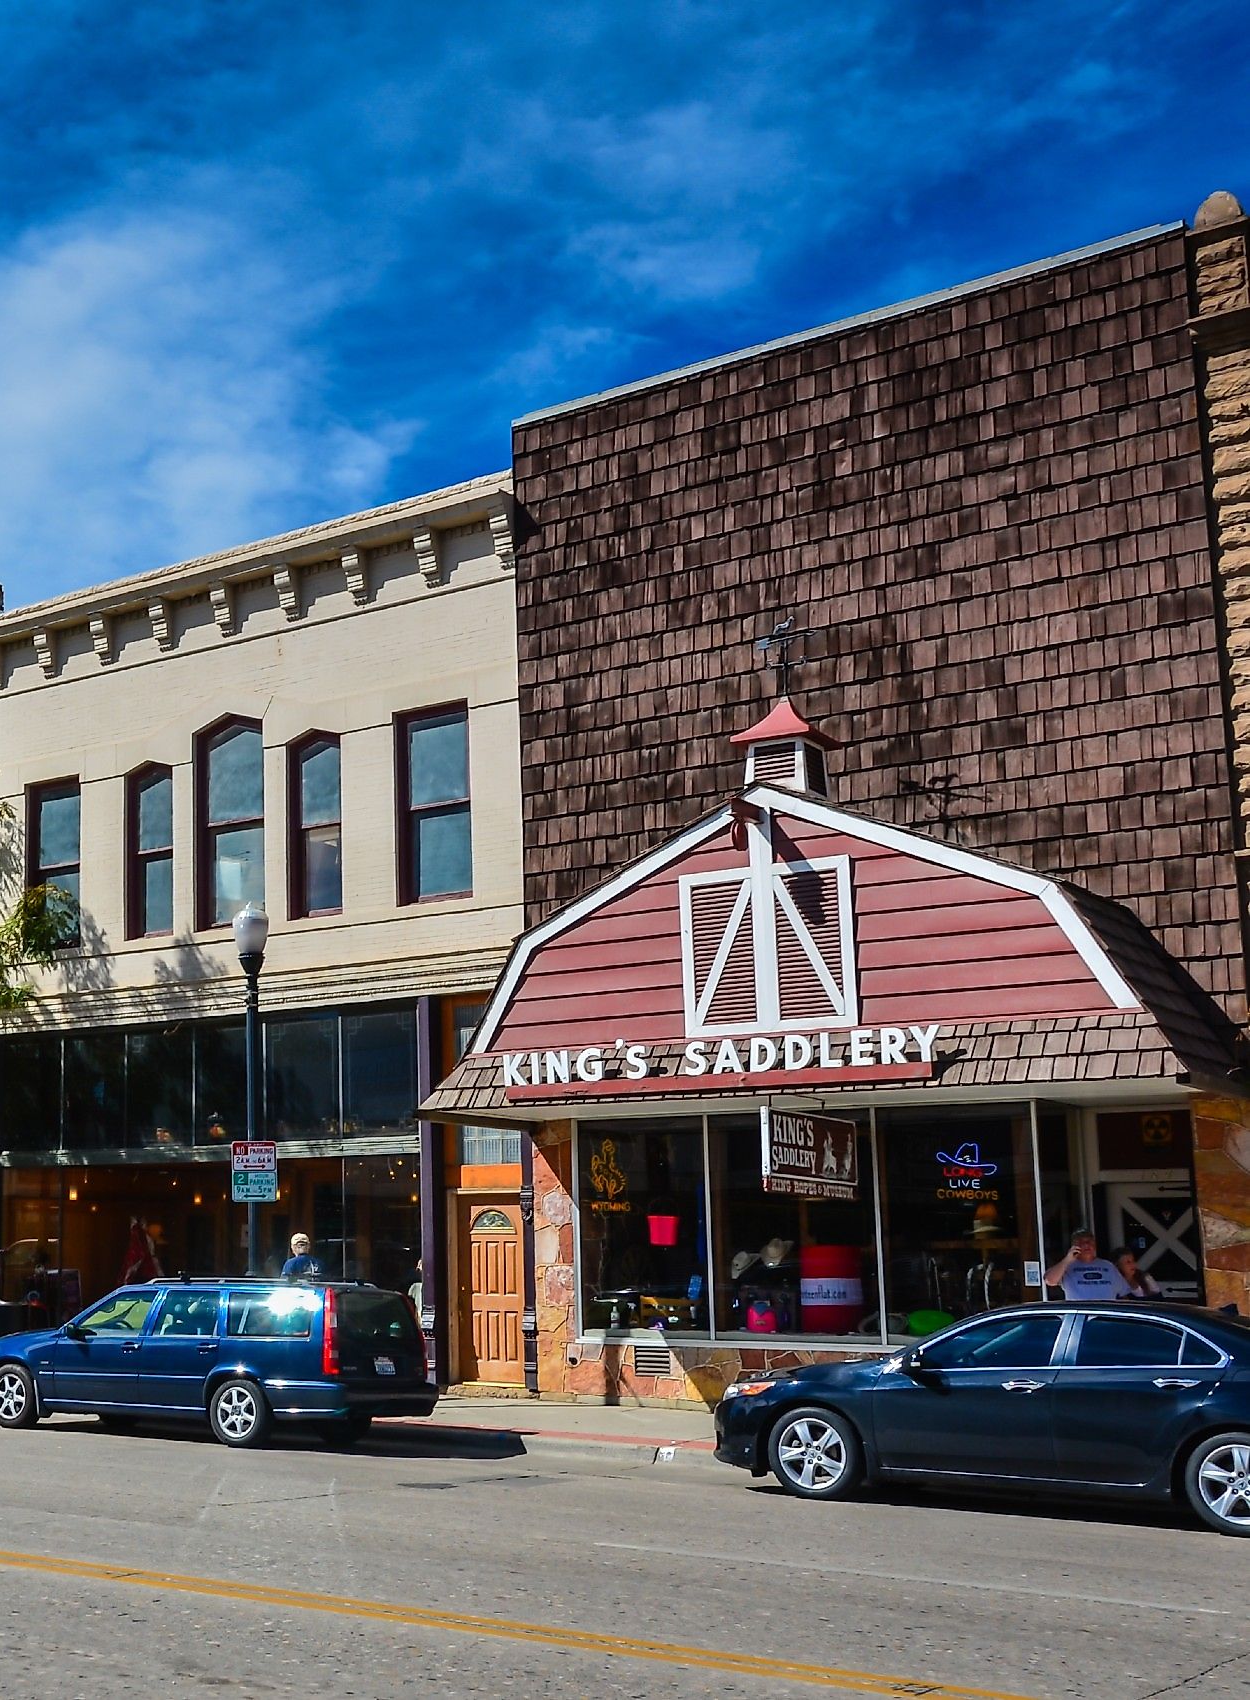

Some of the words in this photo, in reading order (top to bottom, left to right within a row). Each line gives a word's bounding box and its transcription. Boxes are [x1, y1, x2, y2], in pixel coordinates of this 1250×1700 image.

[502, 1038, 649, 1086] KING'S
[684, 1024, 940, 1077] SADDLERY
[772, 1114, 814, 1147] KING'S
[236, 1146, 245, 1155] NO
[250, 1147, 274, 1155] PARKING
[771, 1145, 817, 1175] SADDLERY
[943, 1167, 982, 1178] LONG
[237, 1174, 245, 1184] 2
[950, 1179, 981, 1189] LIVE
[771, 1178, 791, 1192] KING
[793, 1180, 817, 1195] ROPES
[823, 1184, 854, 1199] MUSEUM
[936, 1188, 999, 1201] COWBOYS
[591, 1201, 630, 1212] WYOMING
